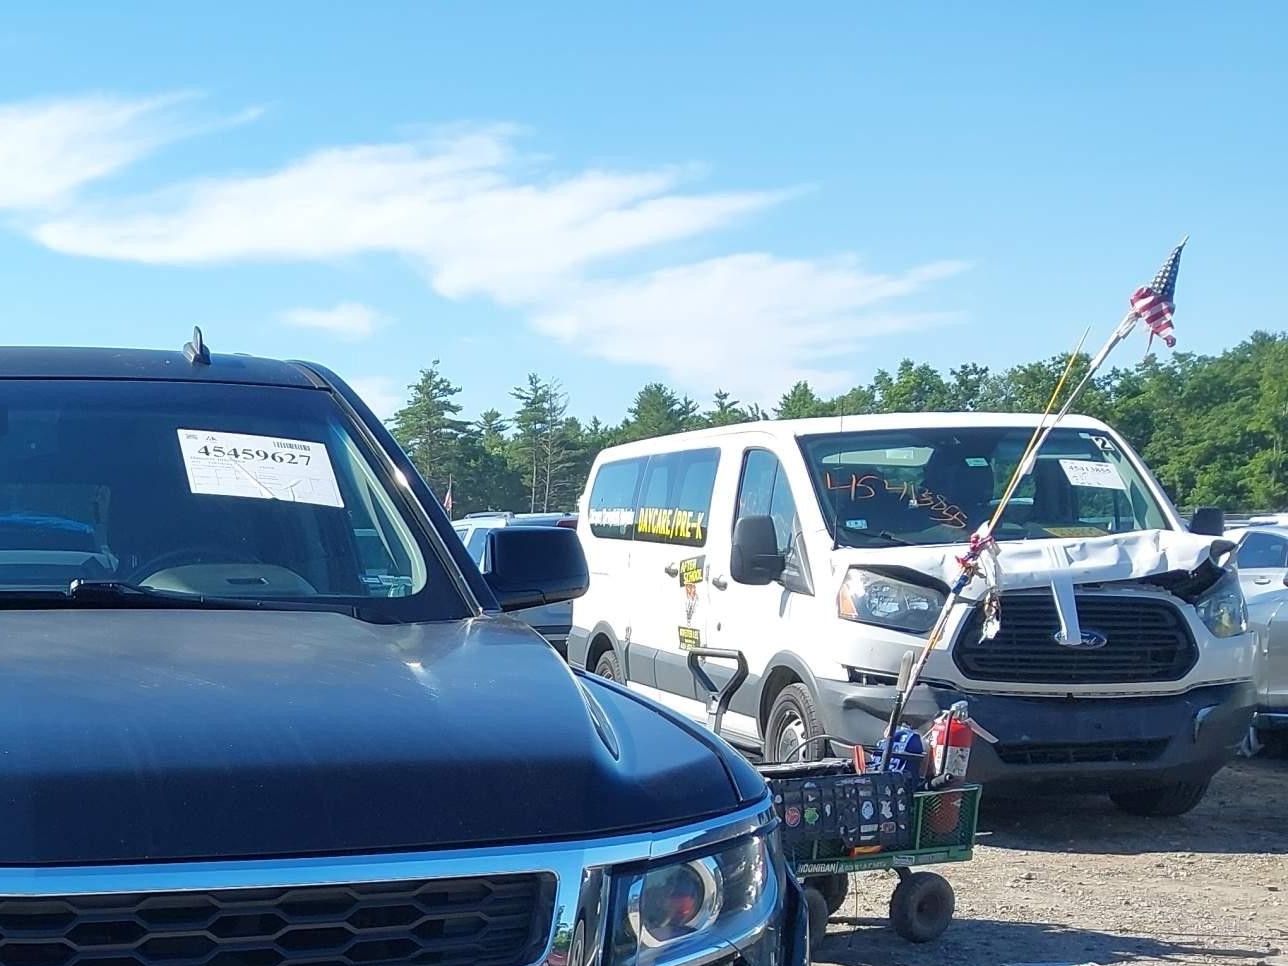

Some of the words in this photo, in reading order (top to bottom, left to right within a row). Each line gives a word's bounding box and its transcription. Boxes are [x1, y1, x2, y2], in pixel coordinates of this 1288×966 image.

[1094, 437, 1112, 450] 2
[198, 445, 311, 466] 45459627
[638, 508, 704, 540] DAYCARE/PRE-K
